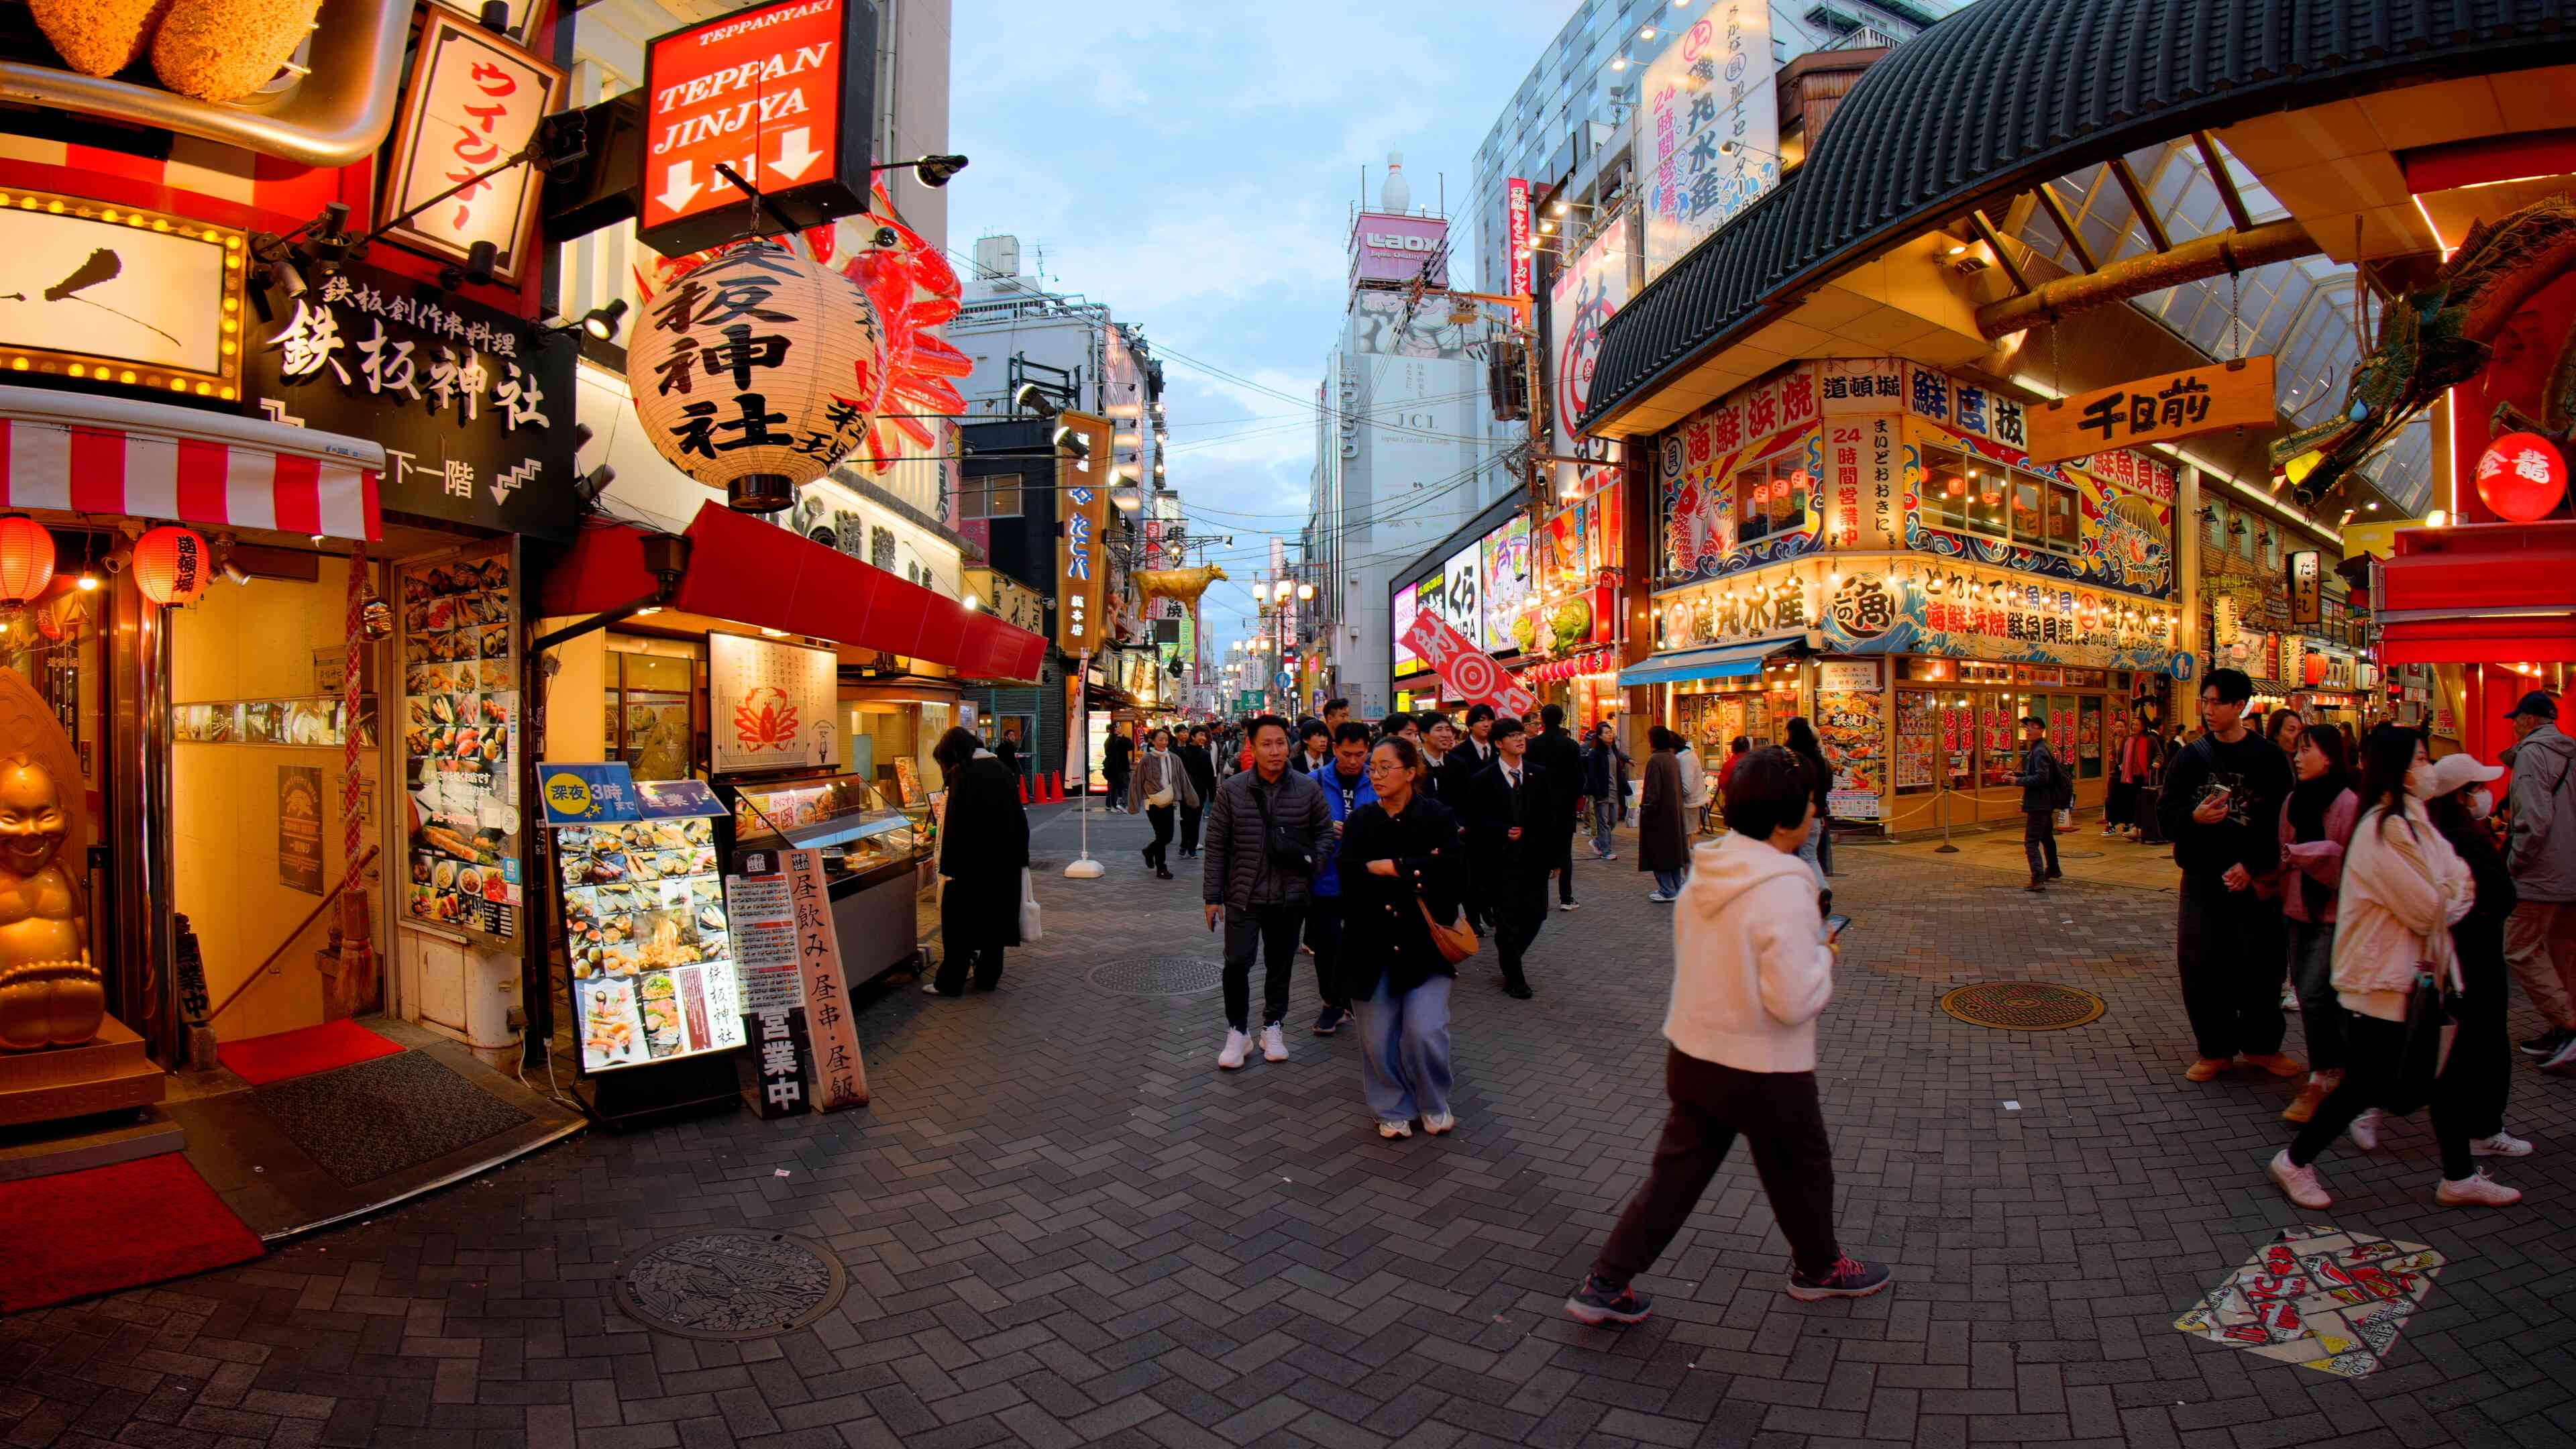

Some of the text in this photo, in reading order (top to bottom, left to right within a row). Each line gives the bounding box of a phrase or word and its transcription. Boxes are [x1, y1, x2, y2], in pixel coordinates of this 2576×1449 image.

[700, 0, 834, 46] TEPPANYAKI
[657, 42, 833, 115] TEPPAN
[445, 62, 517, 230] ウインナー
[653, 88, 809, 155] JINJYA
[319, 276, 516, 358] 鉄板創作串料理
[266, 299, 549, 431] 鉄板神社
[1823, 375, 1901, 400] 道頓堀
[1686, 373, 1814, 467] 海鮮浜焼
[2077, 376, 2212, 440] 千日前
[1833, 429, 1862, 546] 24時間営業中
[1873, 419, 1890, 531] まいどおおきに
[2479, 447, 2550, 485] 金龍
[174, 535, 197, 593] 道頓堀
[1449, 565, 1475, 619] くら
[550, 784, 586, 801] 深夜
[590, 782, 623, 799] 3時
[759, 1008, 801, 1112] 営業中
